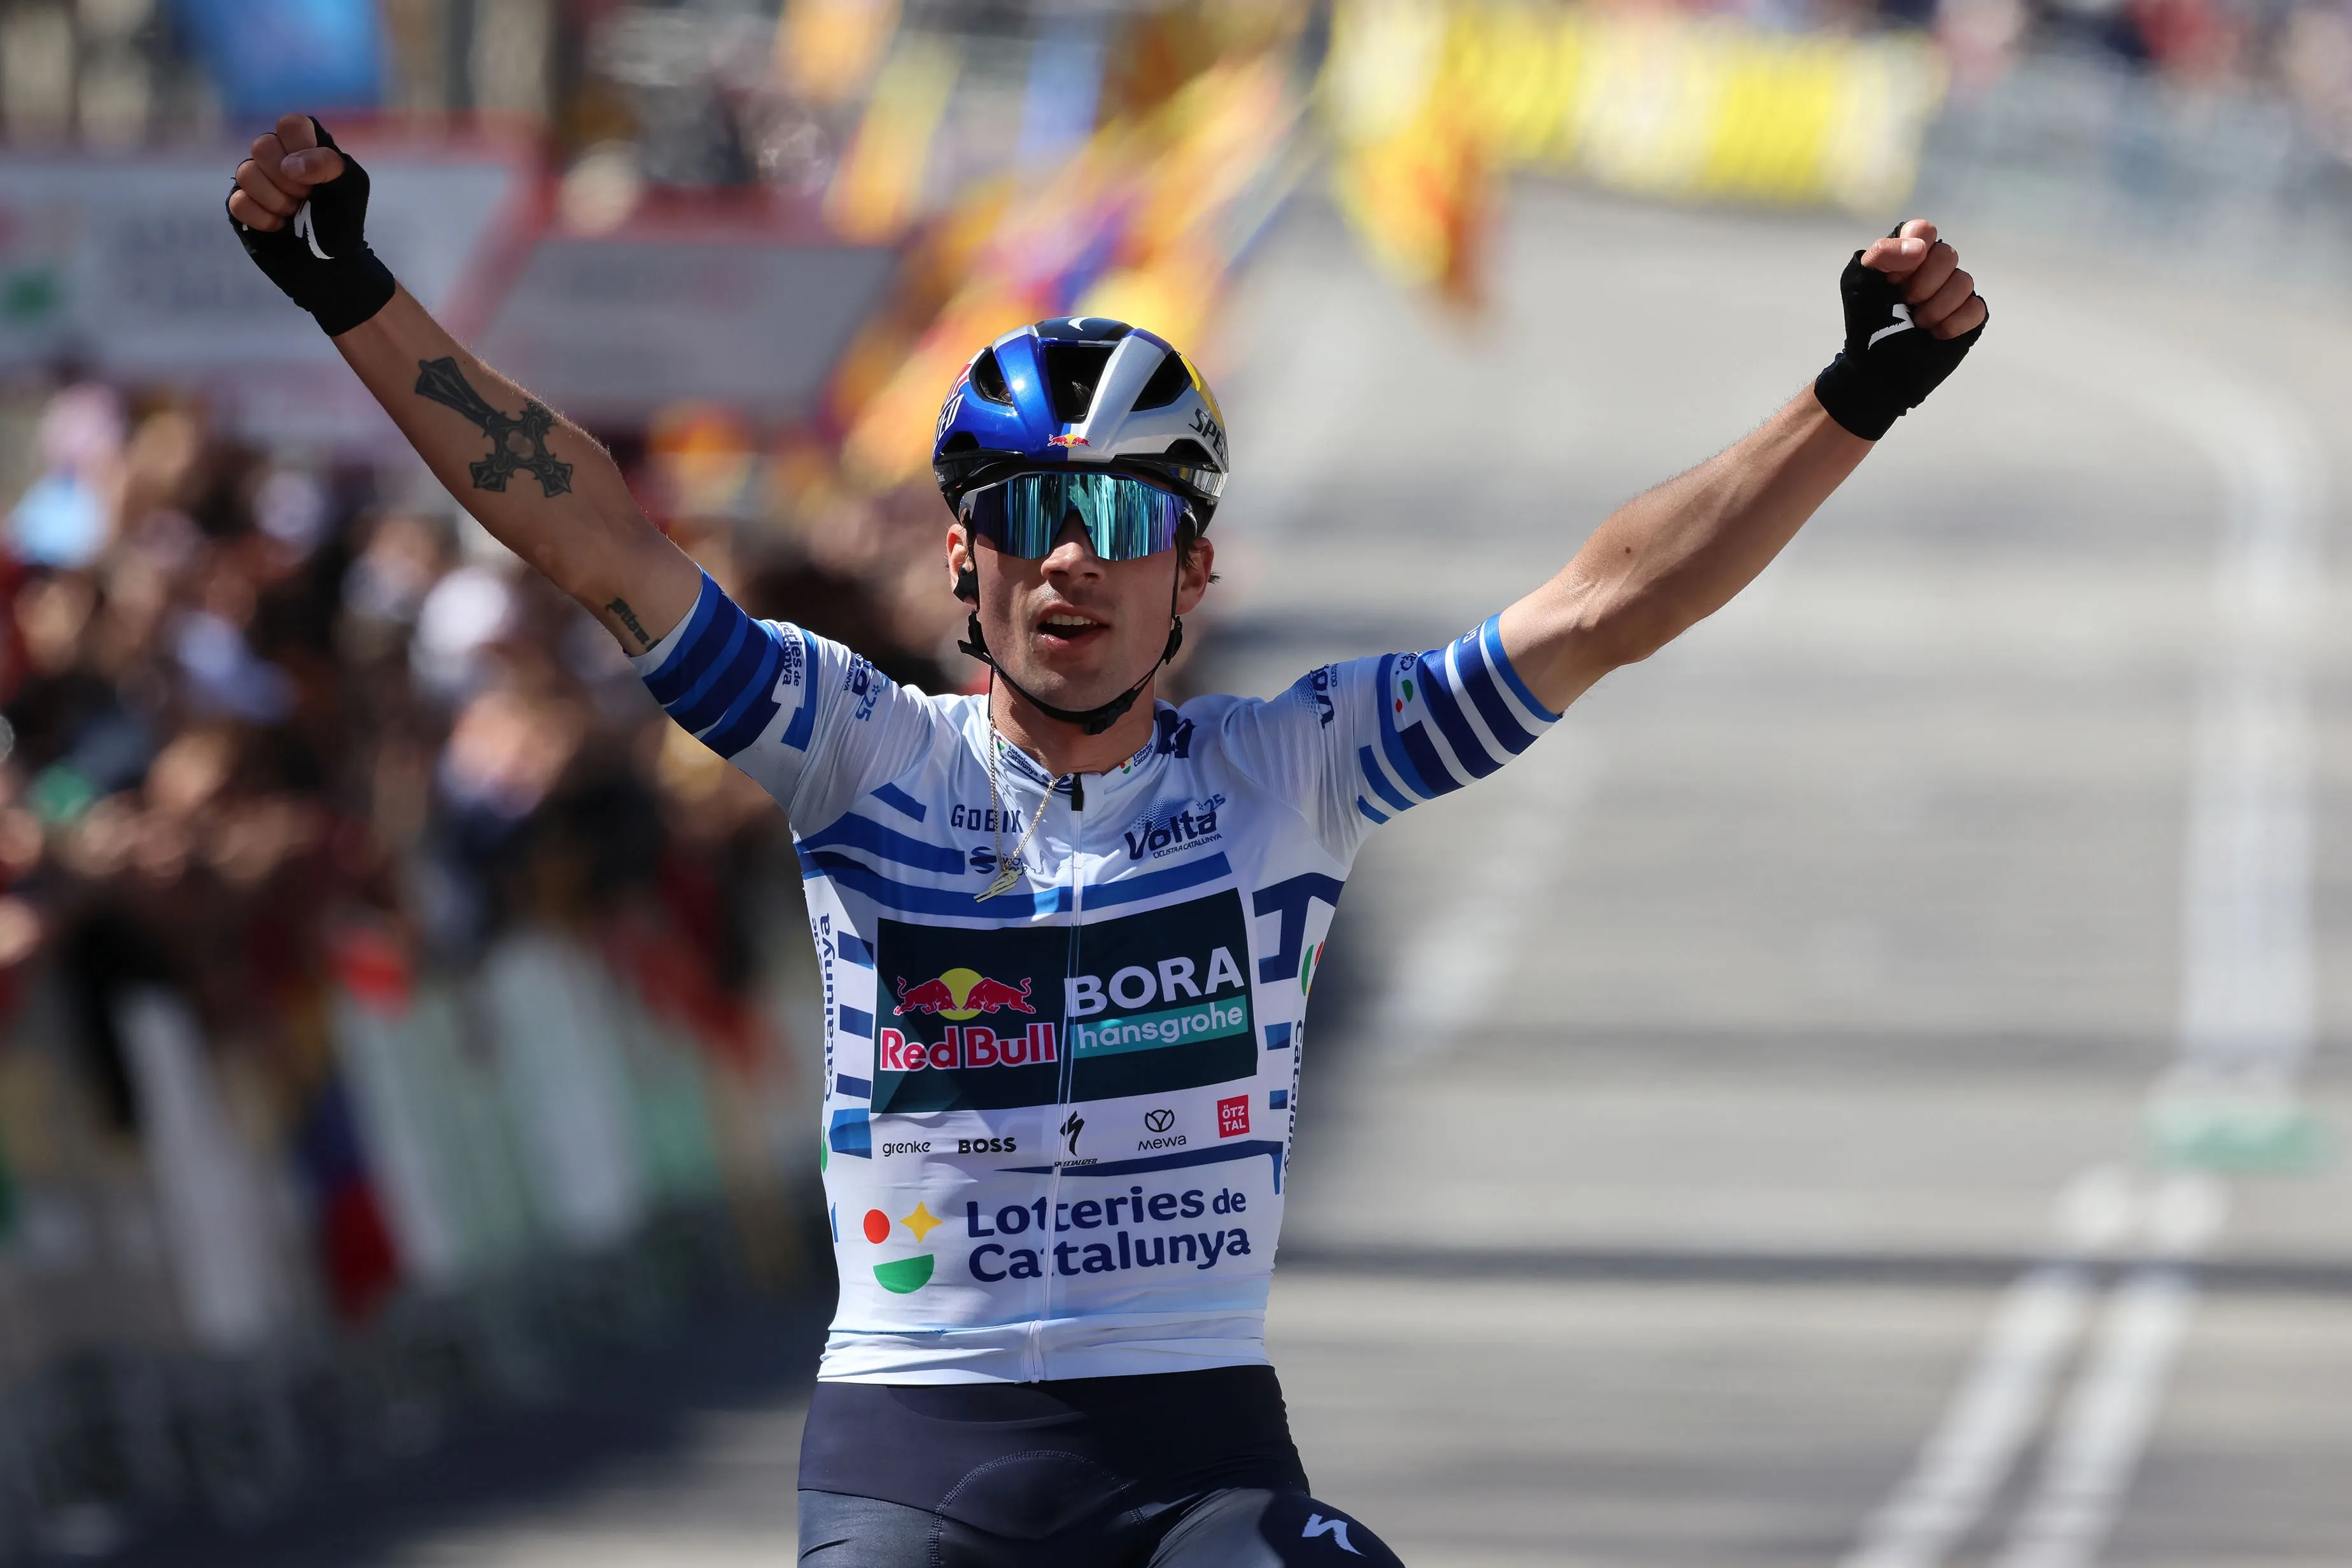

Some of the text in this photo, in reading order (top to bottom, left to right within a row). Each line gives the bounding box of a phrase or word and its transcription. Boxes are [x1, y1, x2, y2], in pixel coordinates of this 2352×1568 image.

[793, 671, 801, 687] de
[951, 804, 1024, 833] GOBIK
[1124, 810, 1217, 860] Volta
[1153, 847, 1177, 858] CICLISTA
[1183, 834, 1222, 850] CATALUNYA
[1064, 946, 1245, 1018] BORA
[820, 913, 835, 1102] Catalunya
[1077, 1002, 1243, 1049] hansgrohe
[880, 1023, 1058, 1072] Red Bull
[1222, 1105, 1245, 1119] ÖTZ
[1223, 1120, 1246, 1131] TAL
[883, 1141, 931, 1157] grenke
[958, 1137, 1017, 1154] BOSS
[1054, 1158, 1098, 1167] SPECIALIZED
[1212, 1188, 1246, 1215] de
[969, 1228, 1251, 1282] Catalunya
